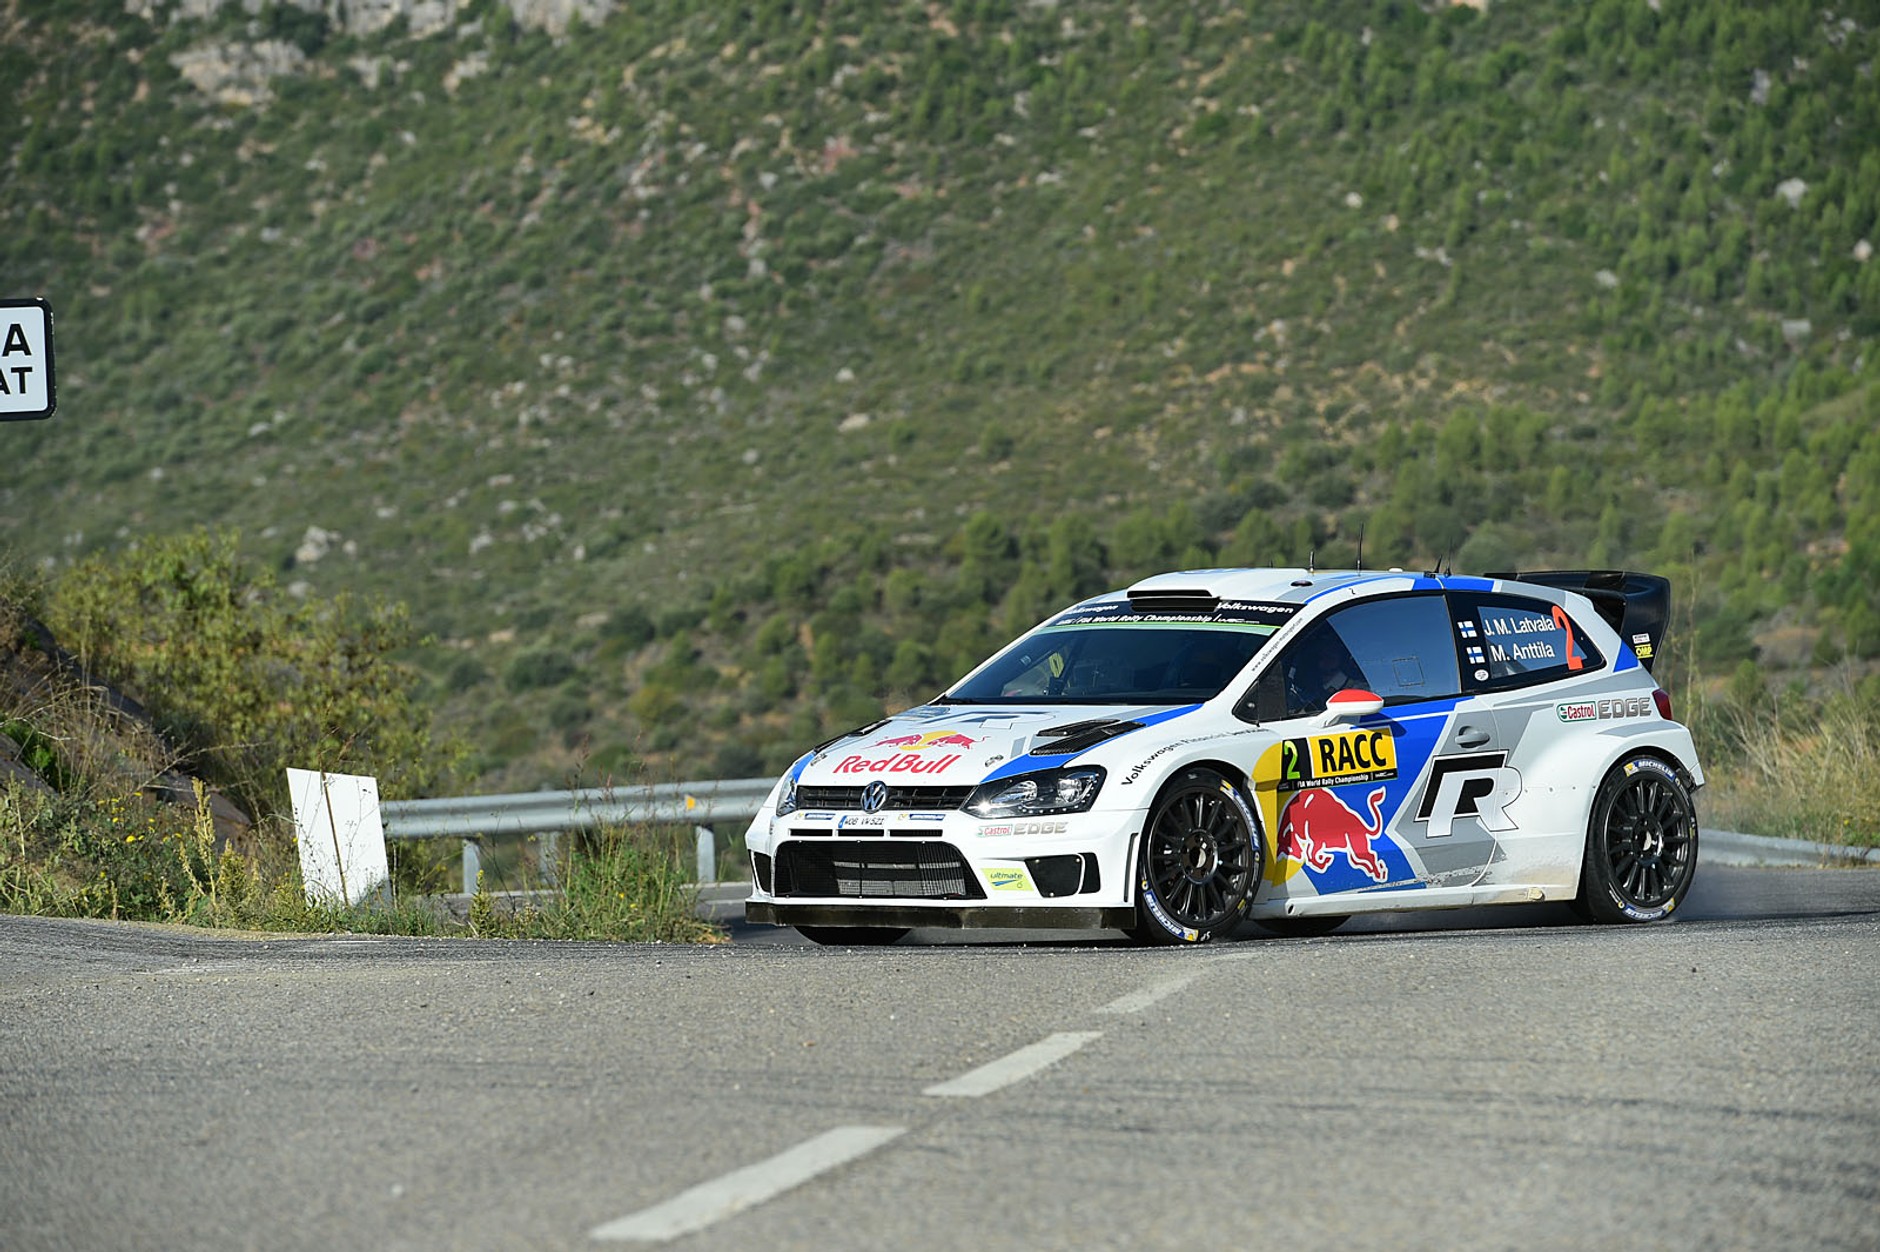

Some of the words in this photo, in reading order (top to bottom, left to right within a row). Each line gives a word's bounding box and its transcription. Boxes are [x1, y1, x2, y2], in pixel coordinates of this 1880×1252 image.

[2, 323, 32, 357] A
[1217, 602, 1294, 613] Volkswagen
[1093, 615, 1118, 623] World
[1120, 614, 1142, 623] Rally
[1143, 614, 1213, 624] Championship
[1484, 619, 1495, 636] J.
[1495, 618, 1511, 635] M.
[1510, 614, 1555, 634] Latvala
[1551, 605, 1584, 671] 2
[1490, 644, 1510, 662] M.
[1513, 641, 1555, 661] Anttila
[1567, 703, 1595, 719] Castrol
[1598, 697, 1652, 719] EDGE
[1121, 741, 1182, 786] Volkswagen
[1284, 740, 1301, 780] 2
[1318, 731, 1387, 774] RACC
[1306, 779, 1321, 787] World
[1322, 778, 1334, 786] Rally
[1335, 773, 1369, 784] Championship
[1638, 760, 1674, 778] MICHELIN
[984, 826, 1010, 836] Castrol
[1013, 822, 1069, 835] EDGE
[1146, 891, 1182, 937] MICHELIN
